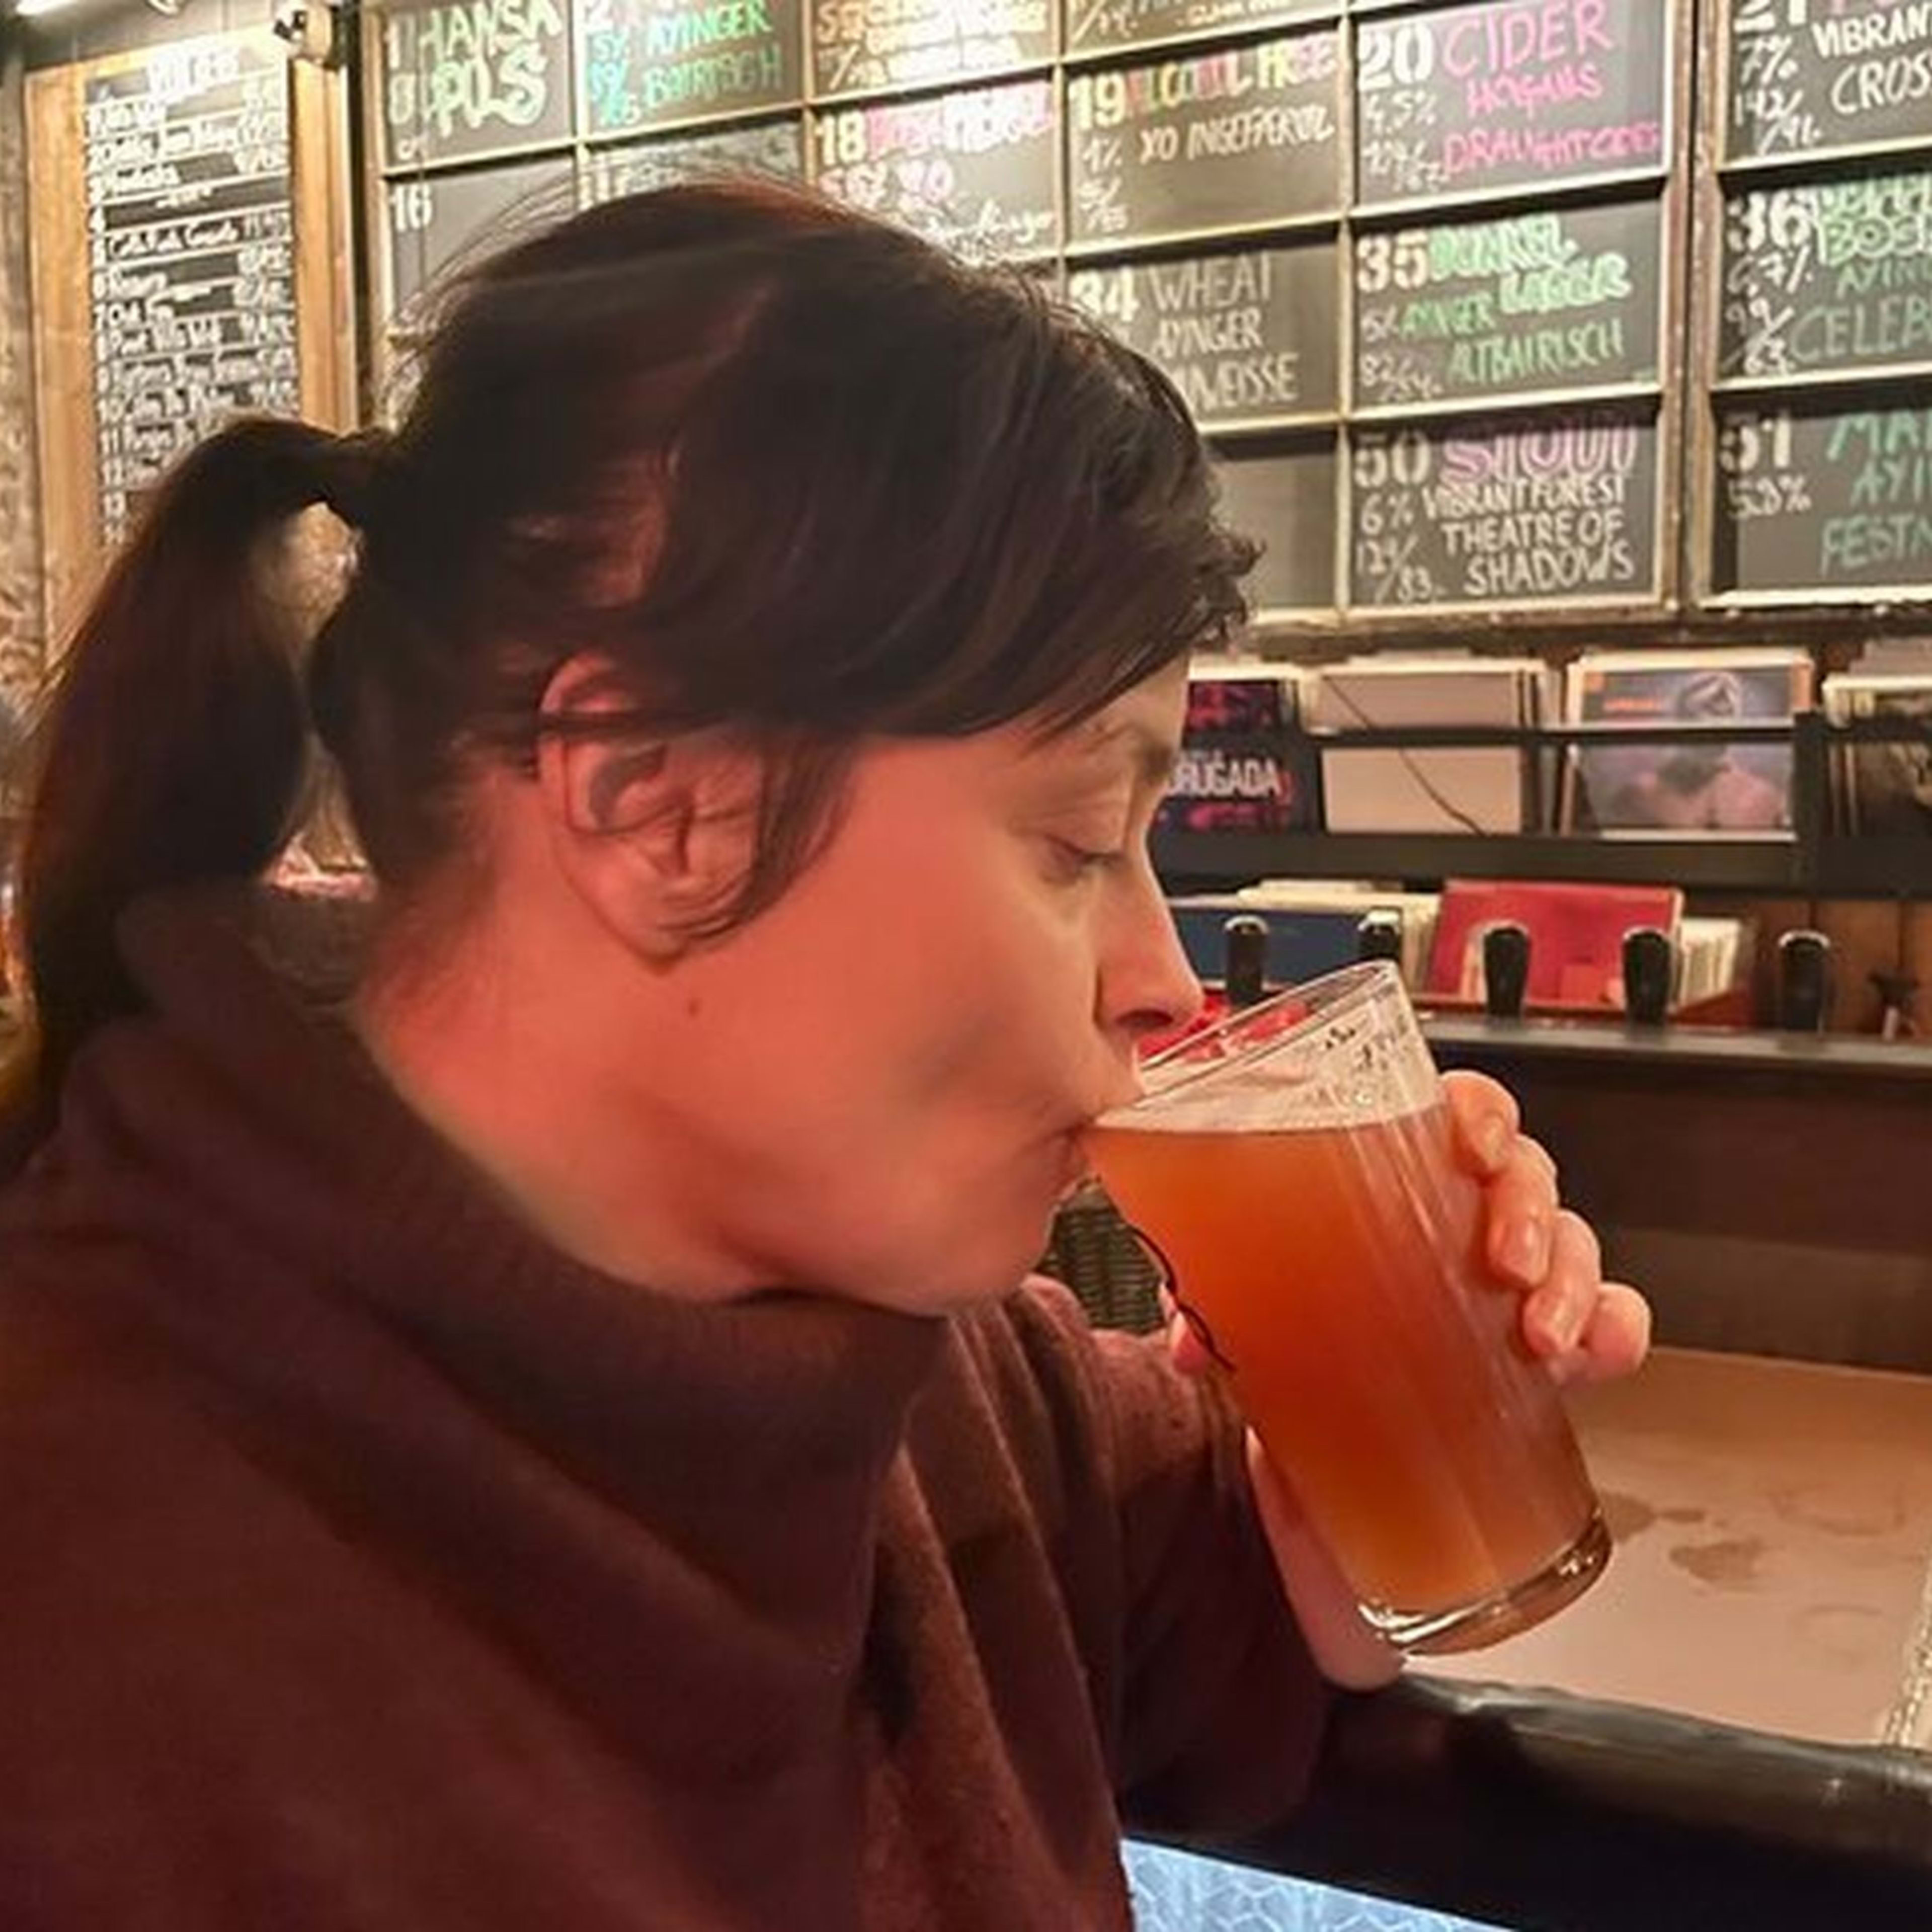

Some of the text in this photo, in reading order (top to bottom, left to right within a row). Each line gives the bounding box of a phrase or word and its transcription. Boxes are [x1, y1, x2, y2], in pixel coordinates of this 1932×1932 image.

[419, 0, 562, 58] HANSA
[1357, 23, 1434, 91] 20
[1442, 0, 1613, 76] CIDER
[1069, 72, 1125, 129] 19
[816, 108, 866, 166] 18
[388, 186, 432, 231] 16
[1727, 190, 1812, 251] 36
[1148, 253, 1271, 310] WHEAT
[1357, 229, 1429, 293] 35
[1354, 429, 1430, 488] 50
[1720, 415, 1791, 471] 51
[1849, 454, 1932, 505] AYI
[1441, 507, 1624, 556] THEATRE OF
[1463, 538, 1634, 595] SHADOWS
[1163, 753, 1282, 796] RUGADA
